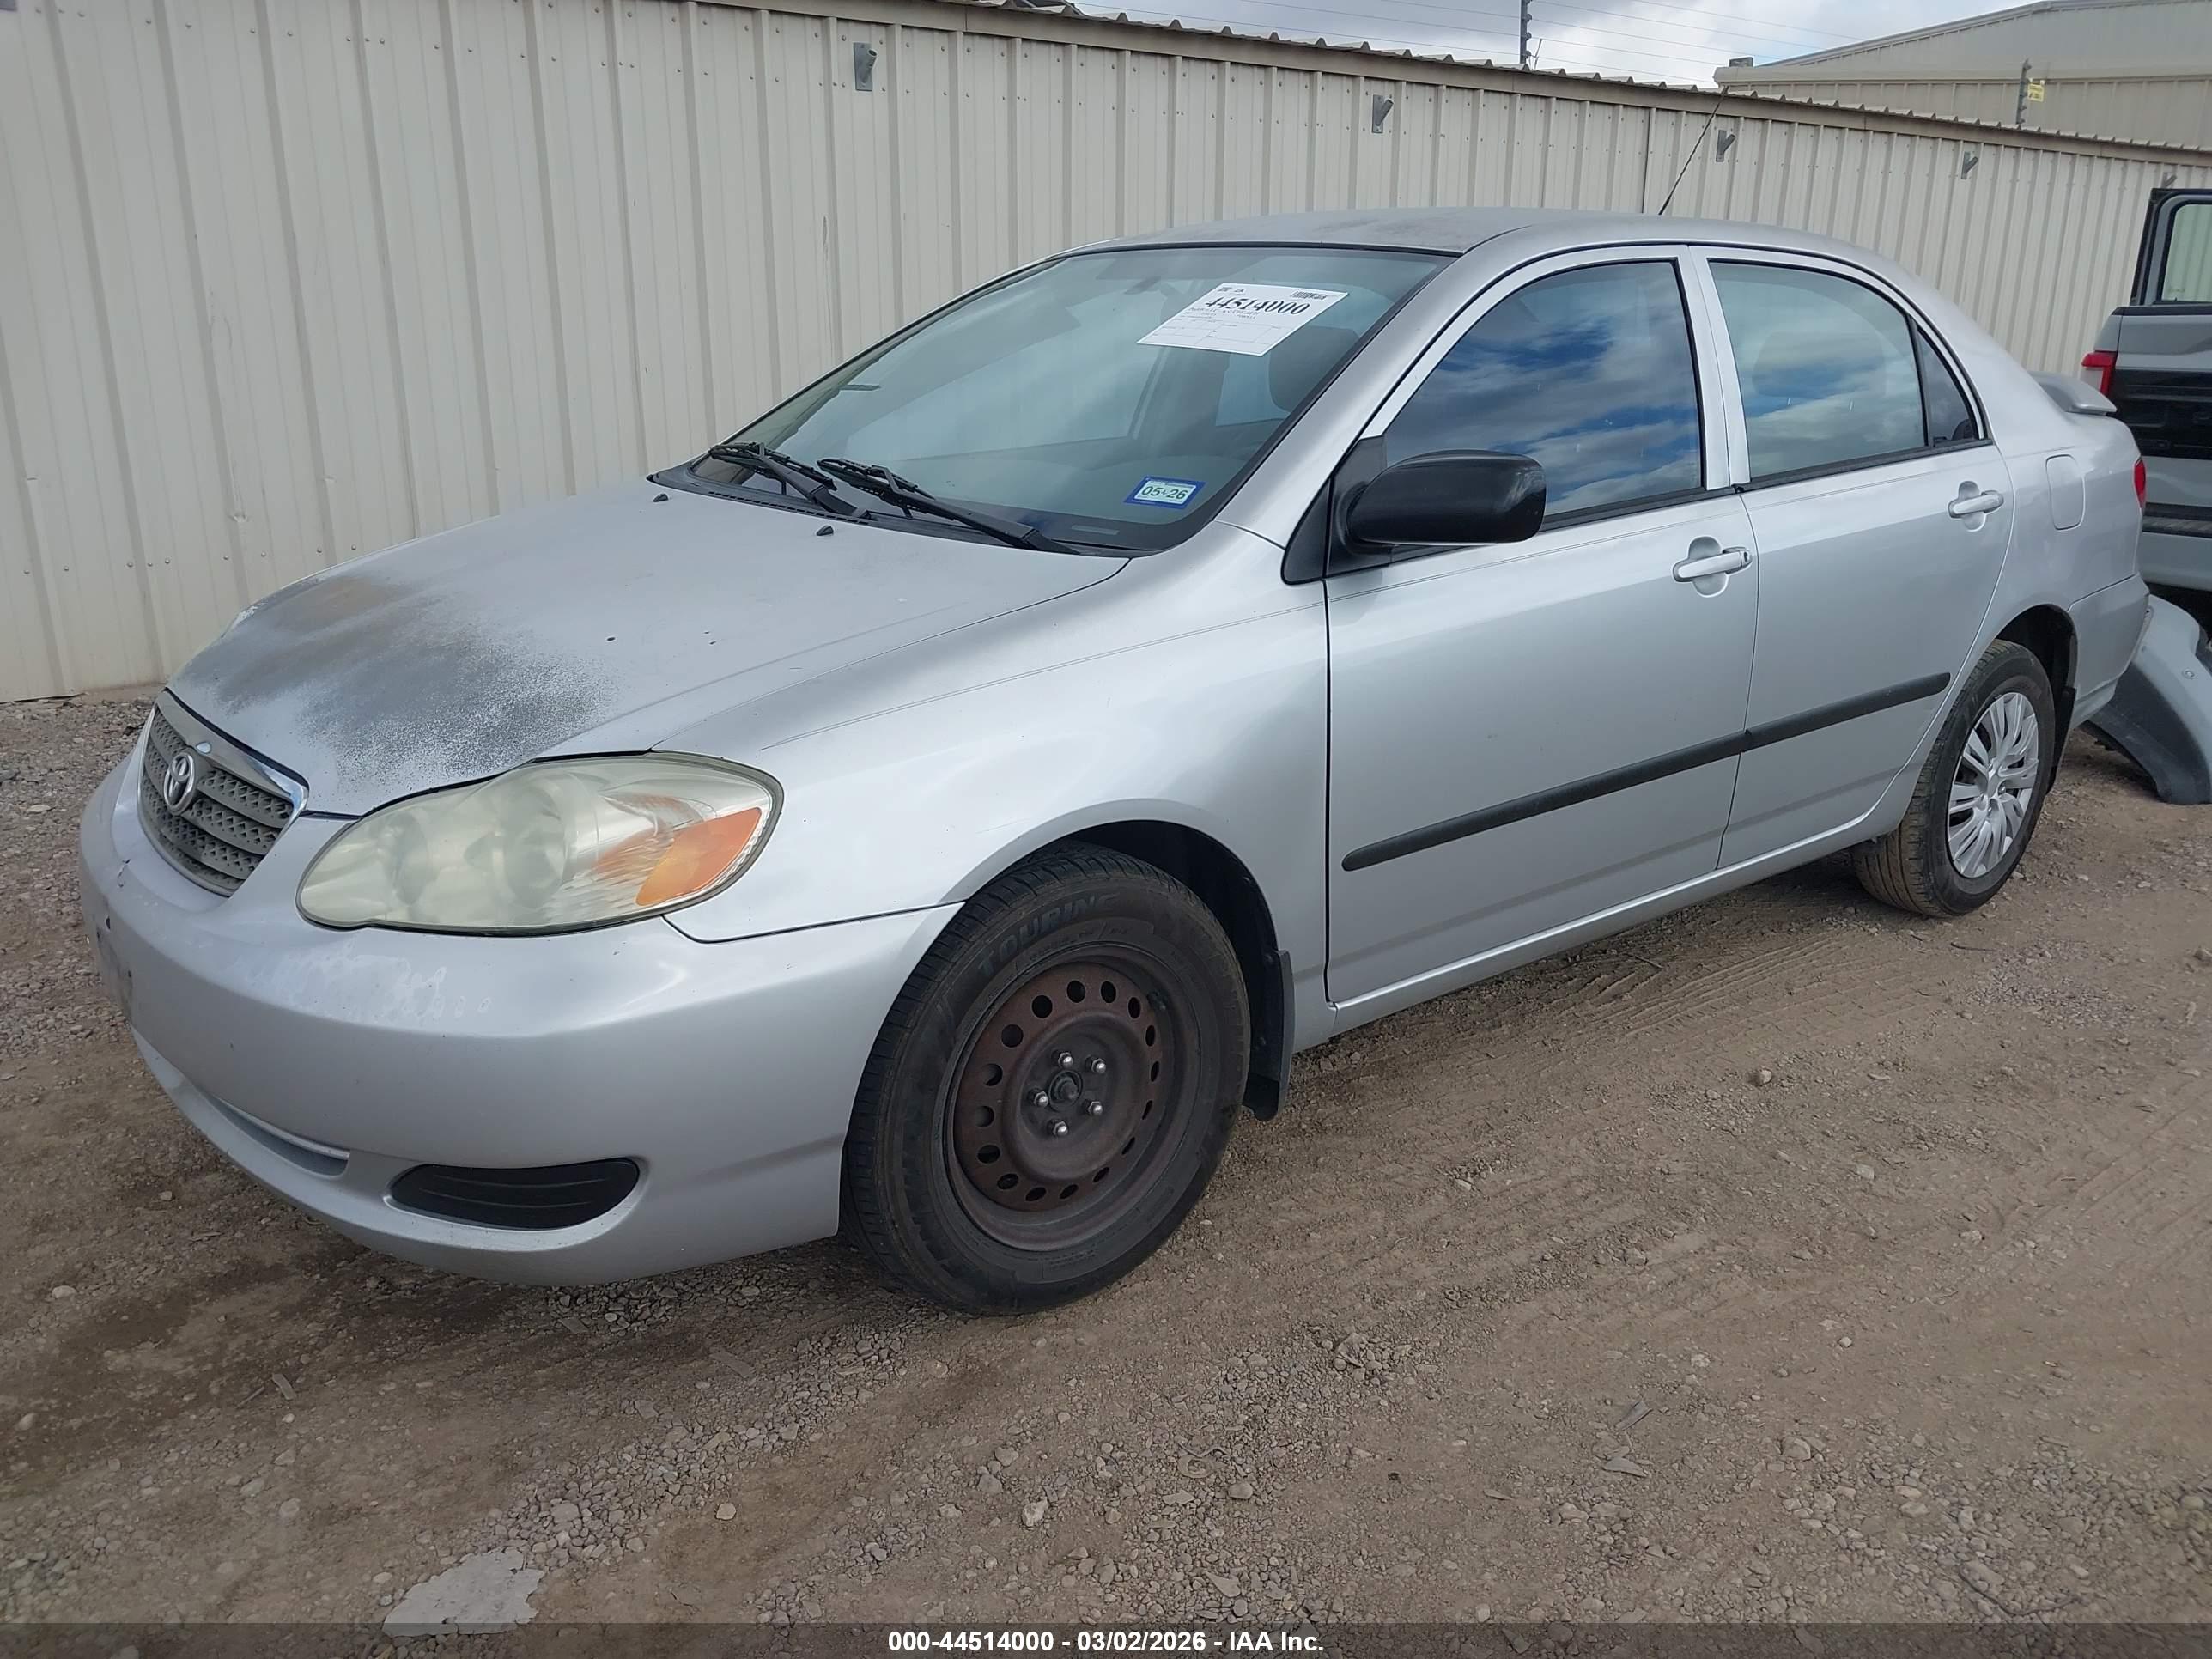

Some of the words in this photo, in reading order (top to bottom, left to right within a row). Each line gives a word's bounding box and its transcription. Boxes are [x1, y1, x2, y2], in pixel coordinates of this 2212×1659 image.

[1205, 296, 1310, 315] 44514000
[1141, 486, 1164, 496] 05
[1166, 489, 1188, 500] 26
